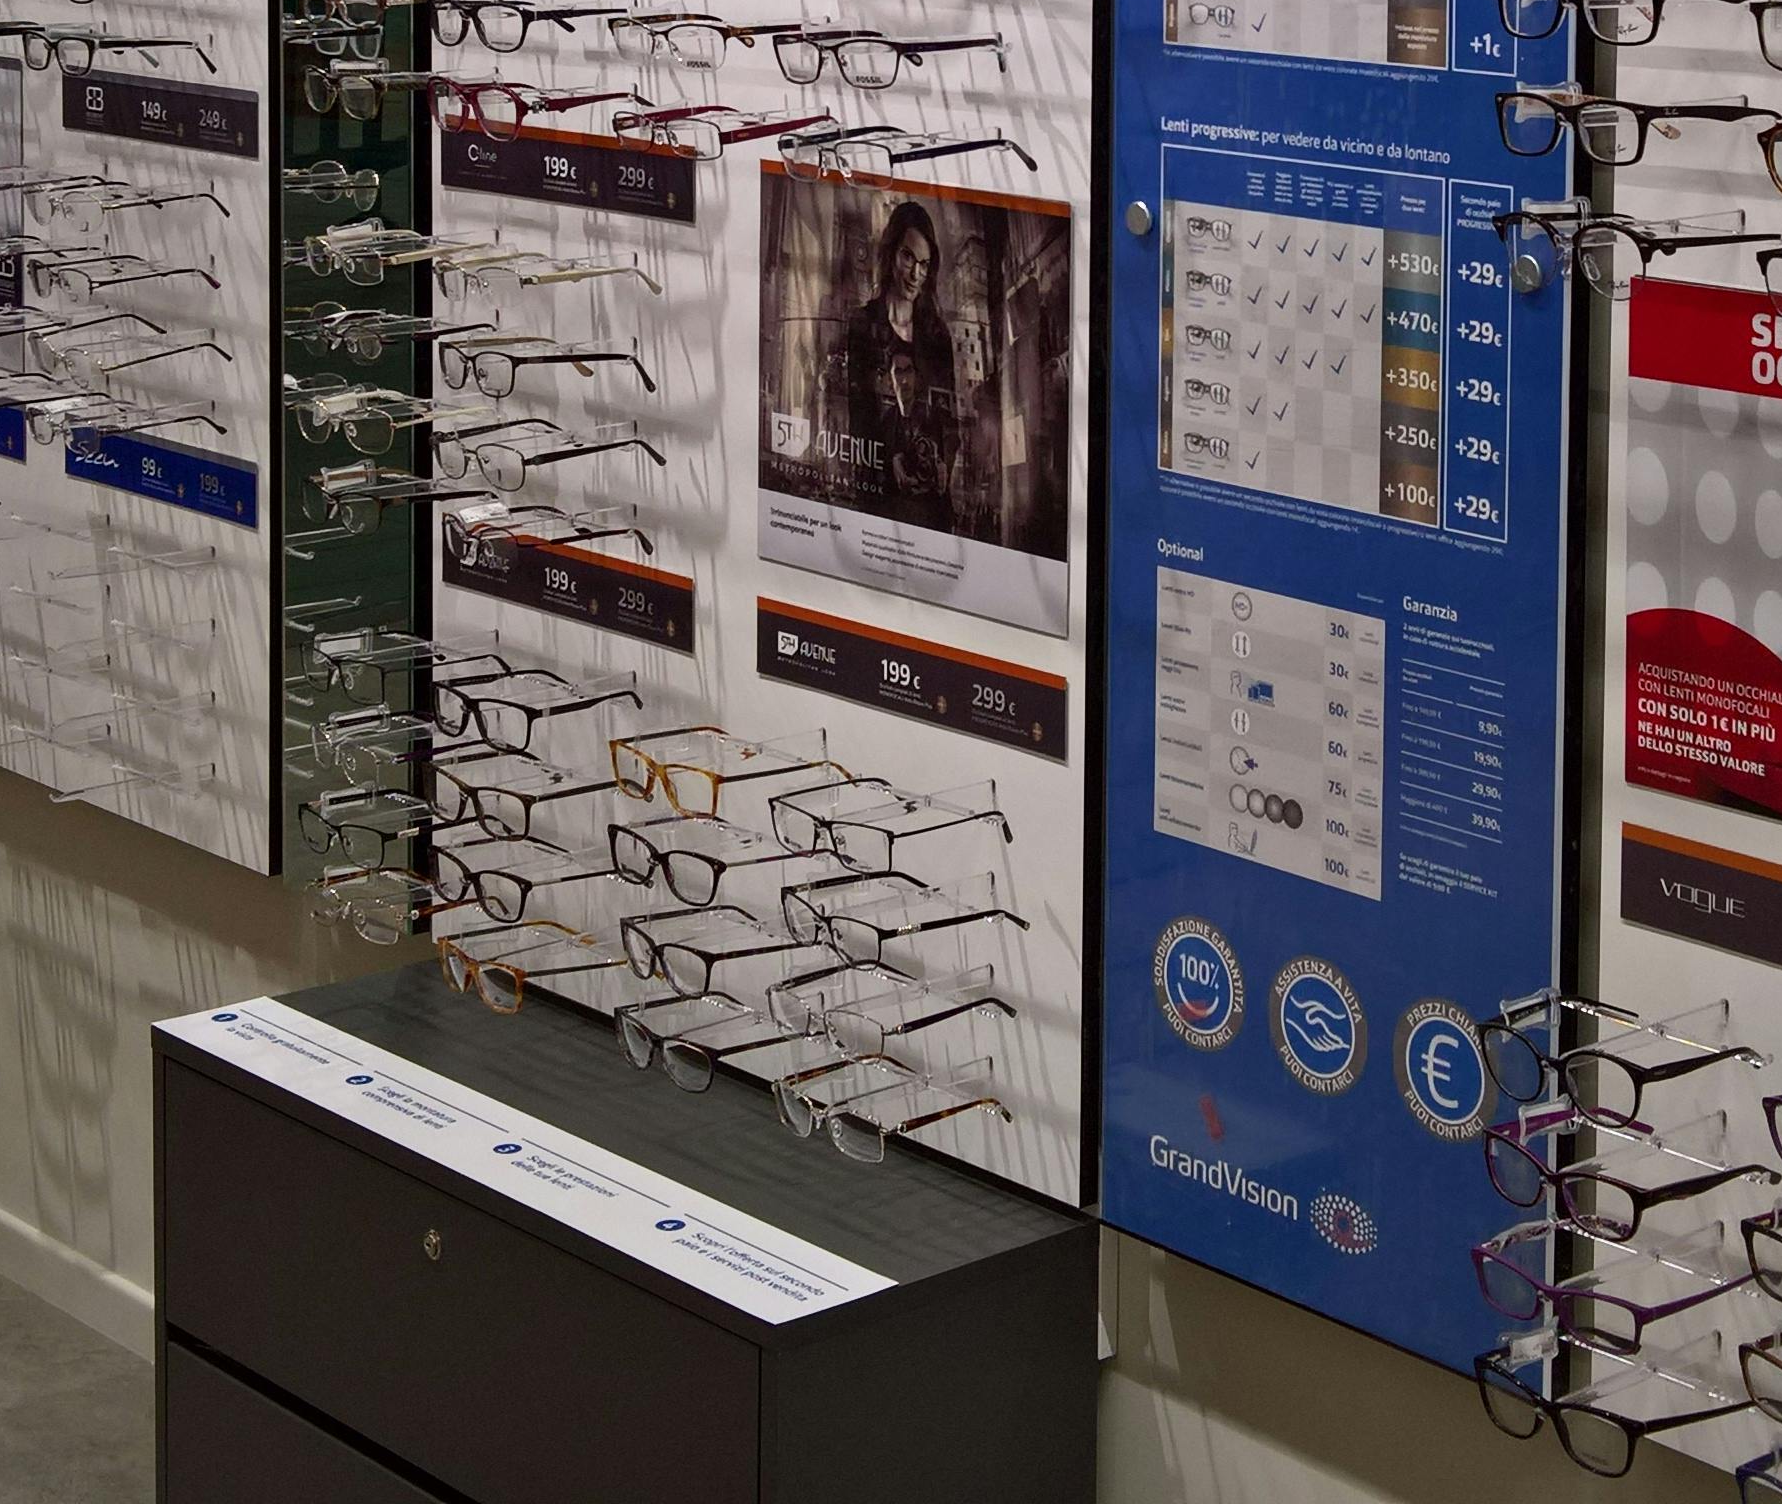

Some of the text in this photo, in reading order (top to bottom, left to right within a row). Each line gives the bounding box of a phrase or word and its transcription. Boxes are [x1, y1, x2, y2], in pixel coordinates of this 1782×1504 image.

[1161, 117, 1450, 164] Lenti progressive: per vedere da vicino e da lontano
[1387, 253, 1504, 289] +530€ +29€
[1387, 309, 1439, 335] +470€
[141, 457, 155, 476] 99
[816, 430, 885, 470] AVENUE
[1157, 538, 1204, 563] Optional
[1403, 596, 1457, 622] Garanzia
[1638, 662, 1715, 689] ACQUISTANDO
[1718, 680, 1734, 694] UN
[1638, 679, 1769, 718] CON LENTI MONOFOCALI
[1638, 698, 1775, 742] CON SOLO 1€ IN PIÙ
[1638, 721, 1731, 753] NE HAI UN ALTRO
[1638, 735, 1765, 777] DELLO STESSO VALORE
[1660, 877, 1746, 919] VOGUE
[1179, 952, 1220, 991] 100%
[1150, 1134, 1299, 1220] GrandVision
